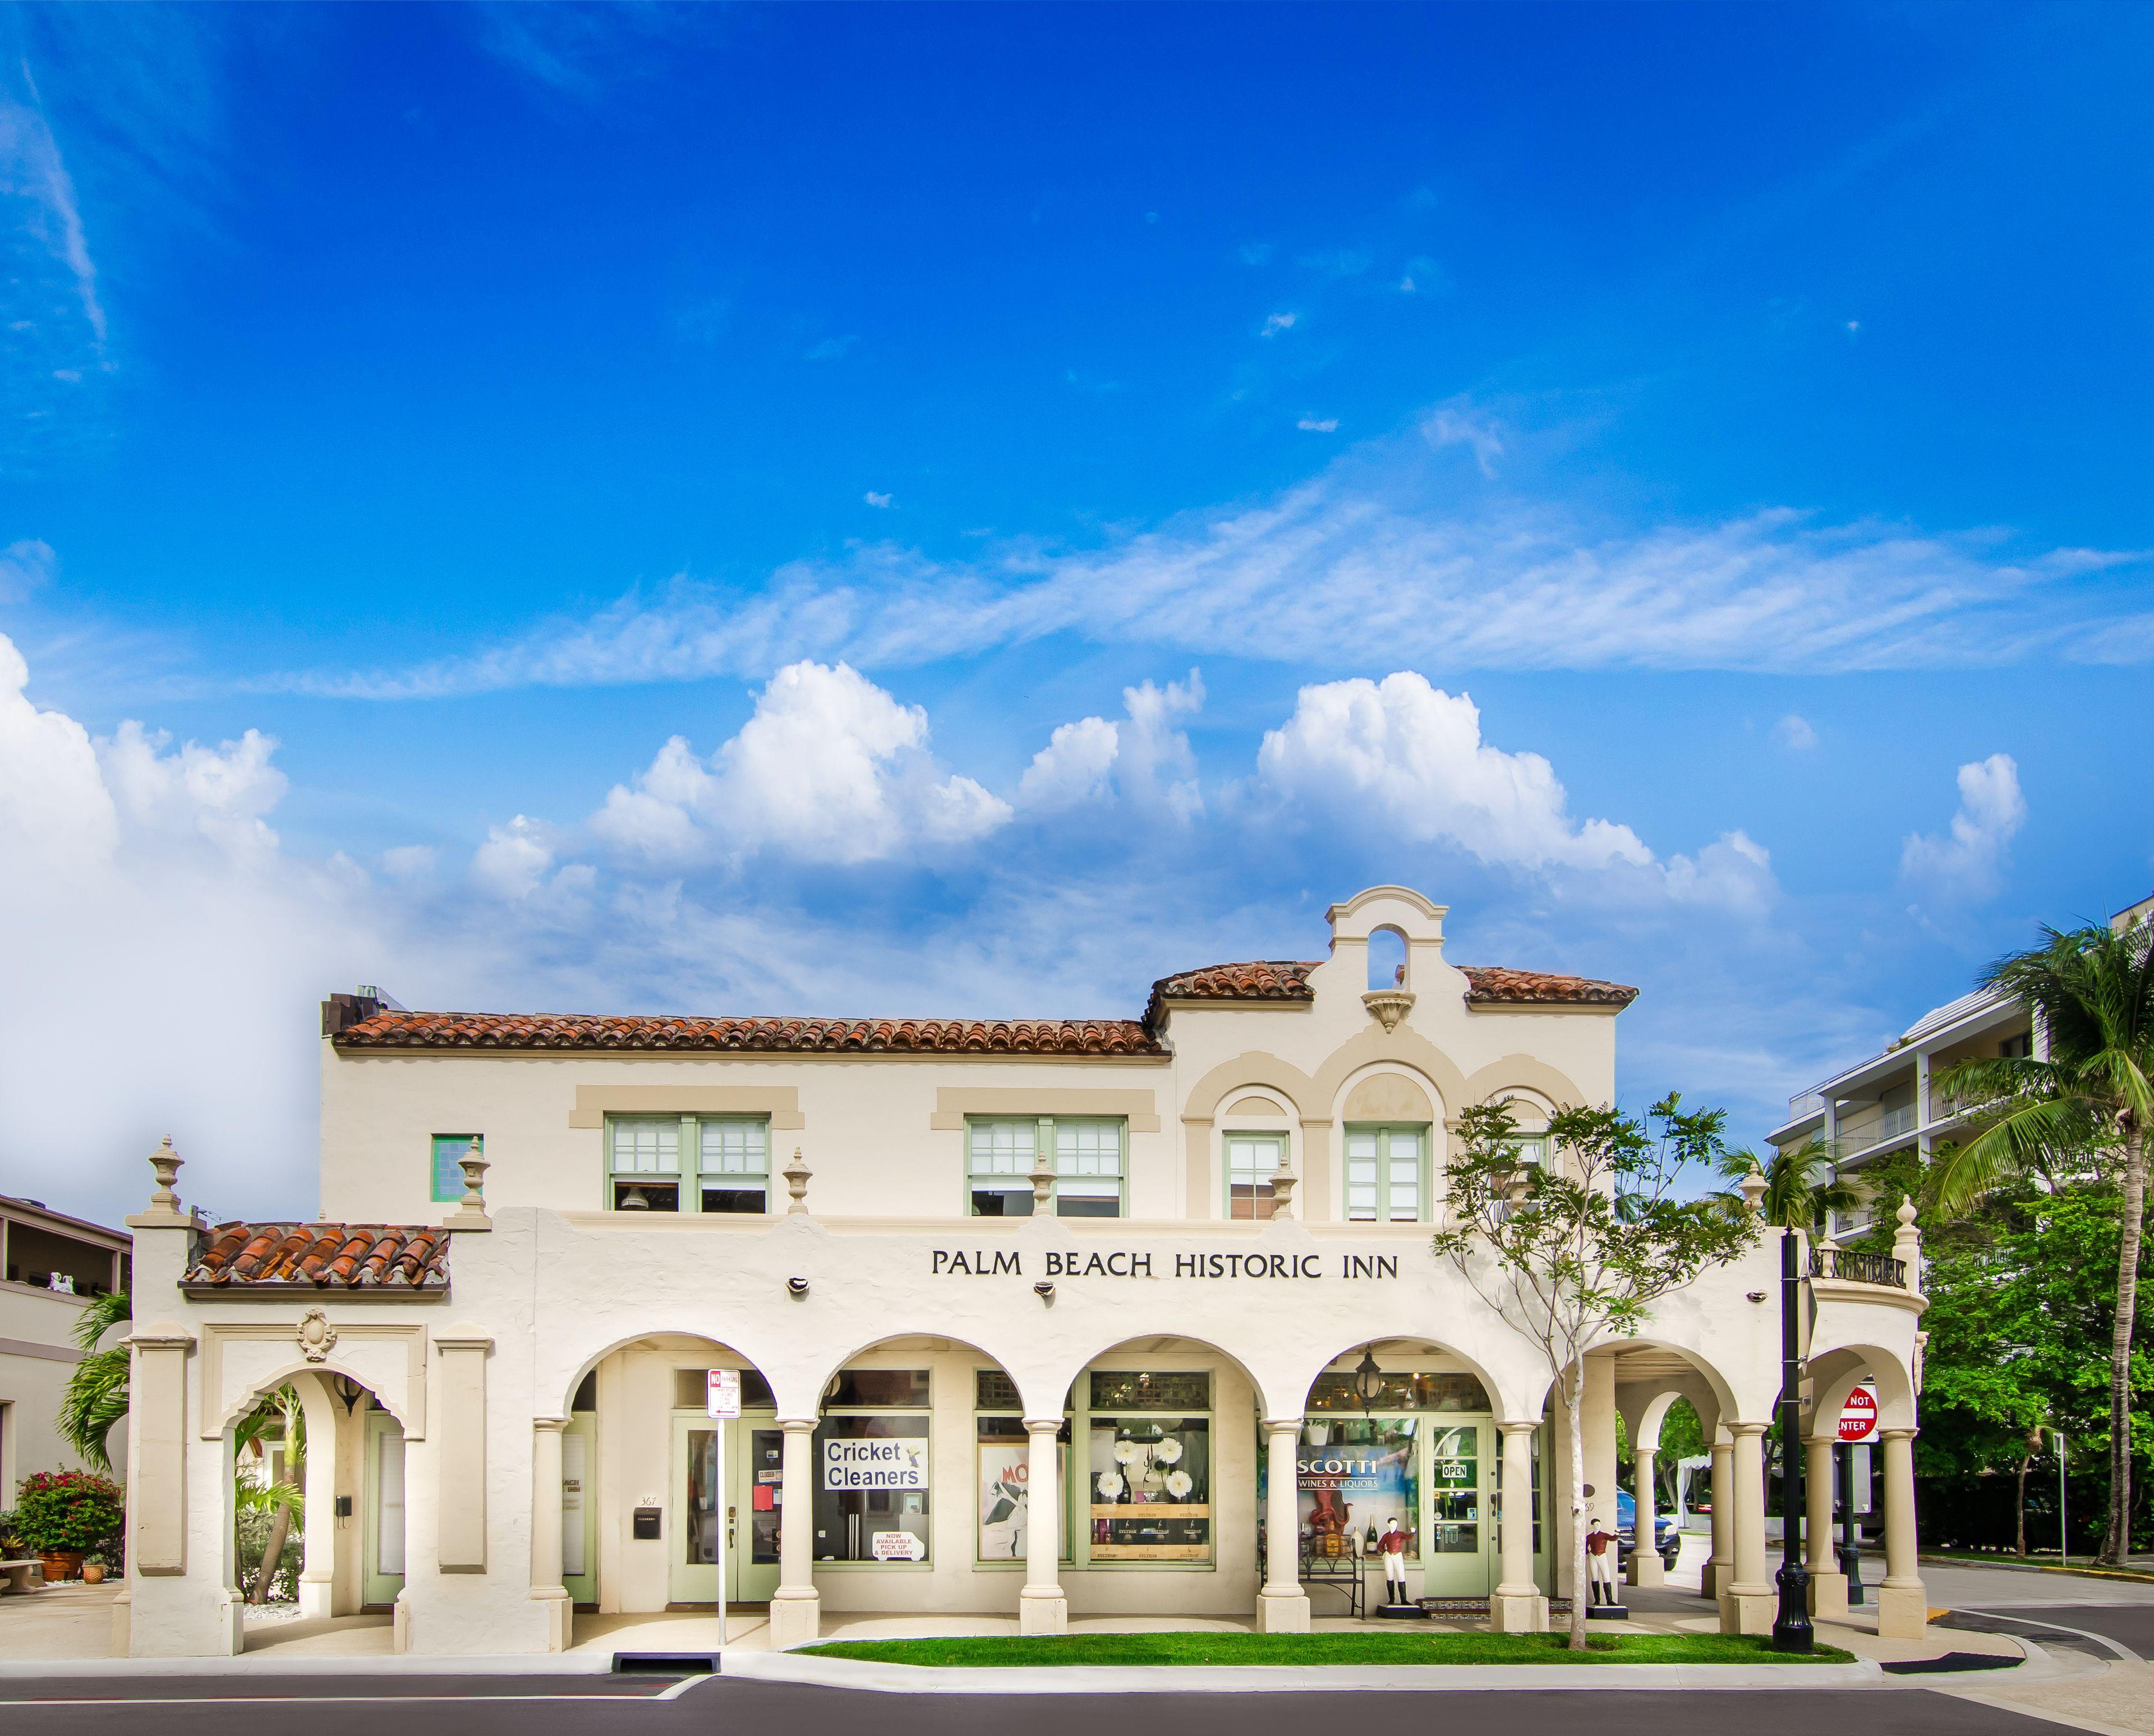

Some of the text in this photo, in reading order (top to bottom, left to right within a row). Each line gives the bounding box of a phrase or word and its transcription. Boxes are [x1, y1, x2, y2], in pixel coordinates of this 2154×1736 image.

[932, 1251, 1398, 1279] PALM BEACH HISTORIC INN
[711, 1374, 720, 1384] NO
[1850, 1396, 1870, 1406] NOT
[1839, 1421, 1866, 1431] NTER
[827, 1442, 901, 1462] Cricket
[1297, 1459, 1378, 1474] SCOTTI
[1444, 1466, 1466, 1476] OPEN
[829, 1467, 919, 1486] Cleaners
[1340, 1480, 1378, 1489] LIQUORS
[641, 1496, 657, 1506] 367
[1585, 1502, 1595, 1512] 69
